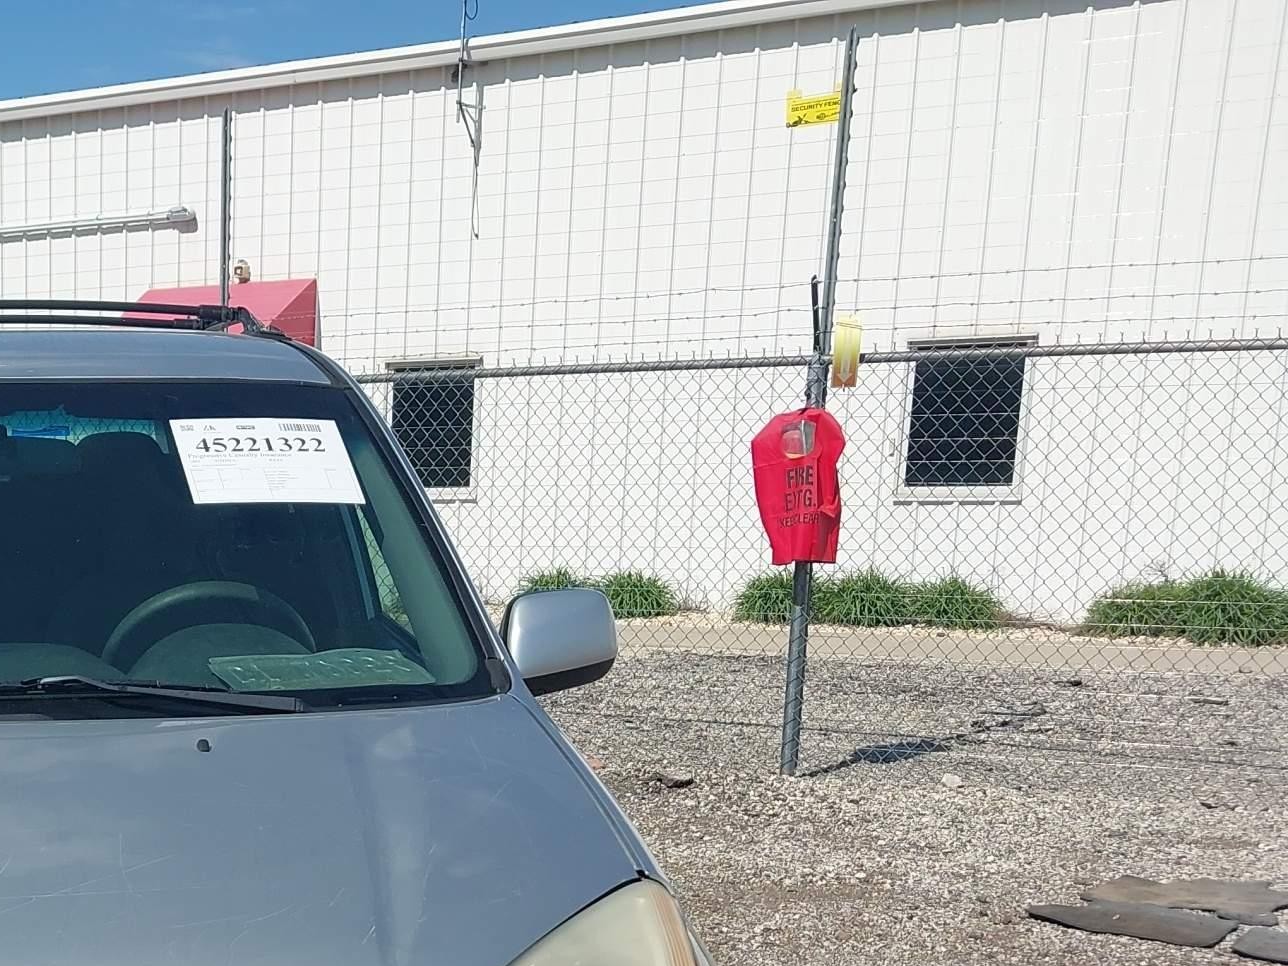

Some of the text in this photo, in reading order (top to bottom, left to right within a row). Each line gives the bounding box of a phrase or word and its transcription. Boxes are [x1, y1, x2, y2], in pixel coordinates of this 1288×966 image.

[791, 100, 841, 112] SECURITY FENC
[195, 437, 326, 453] 45221322
[786, 465, 814, 488] FIRE
